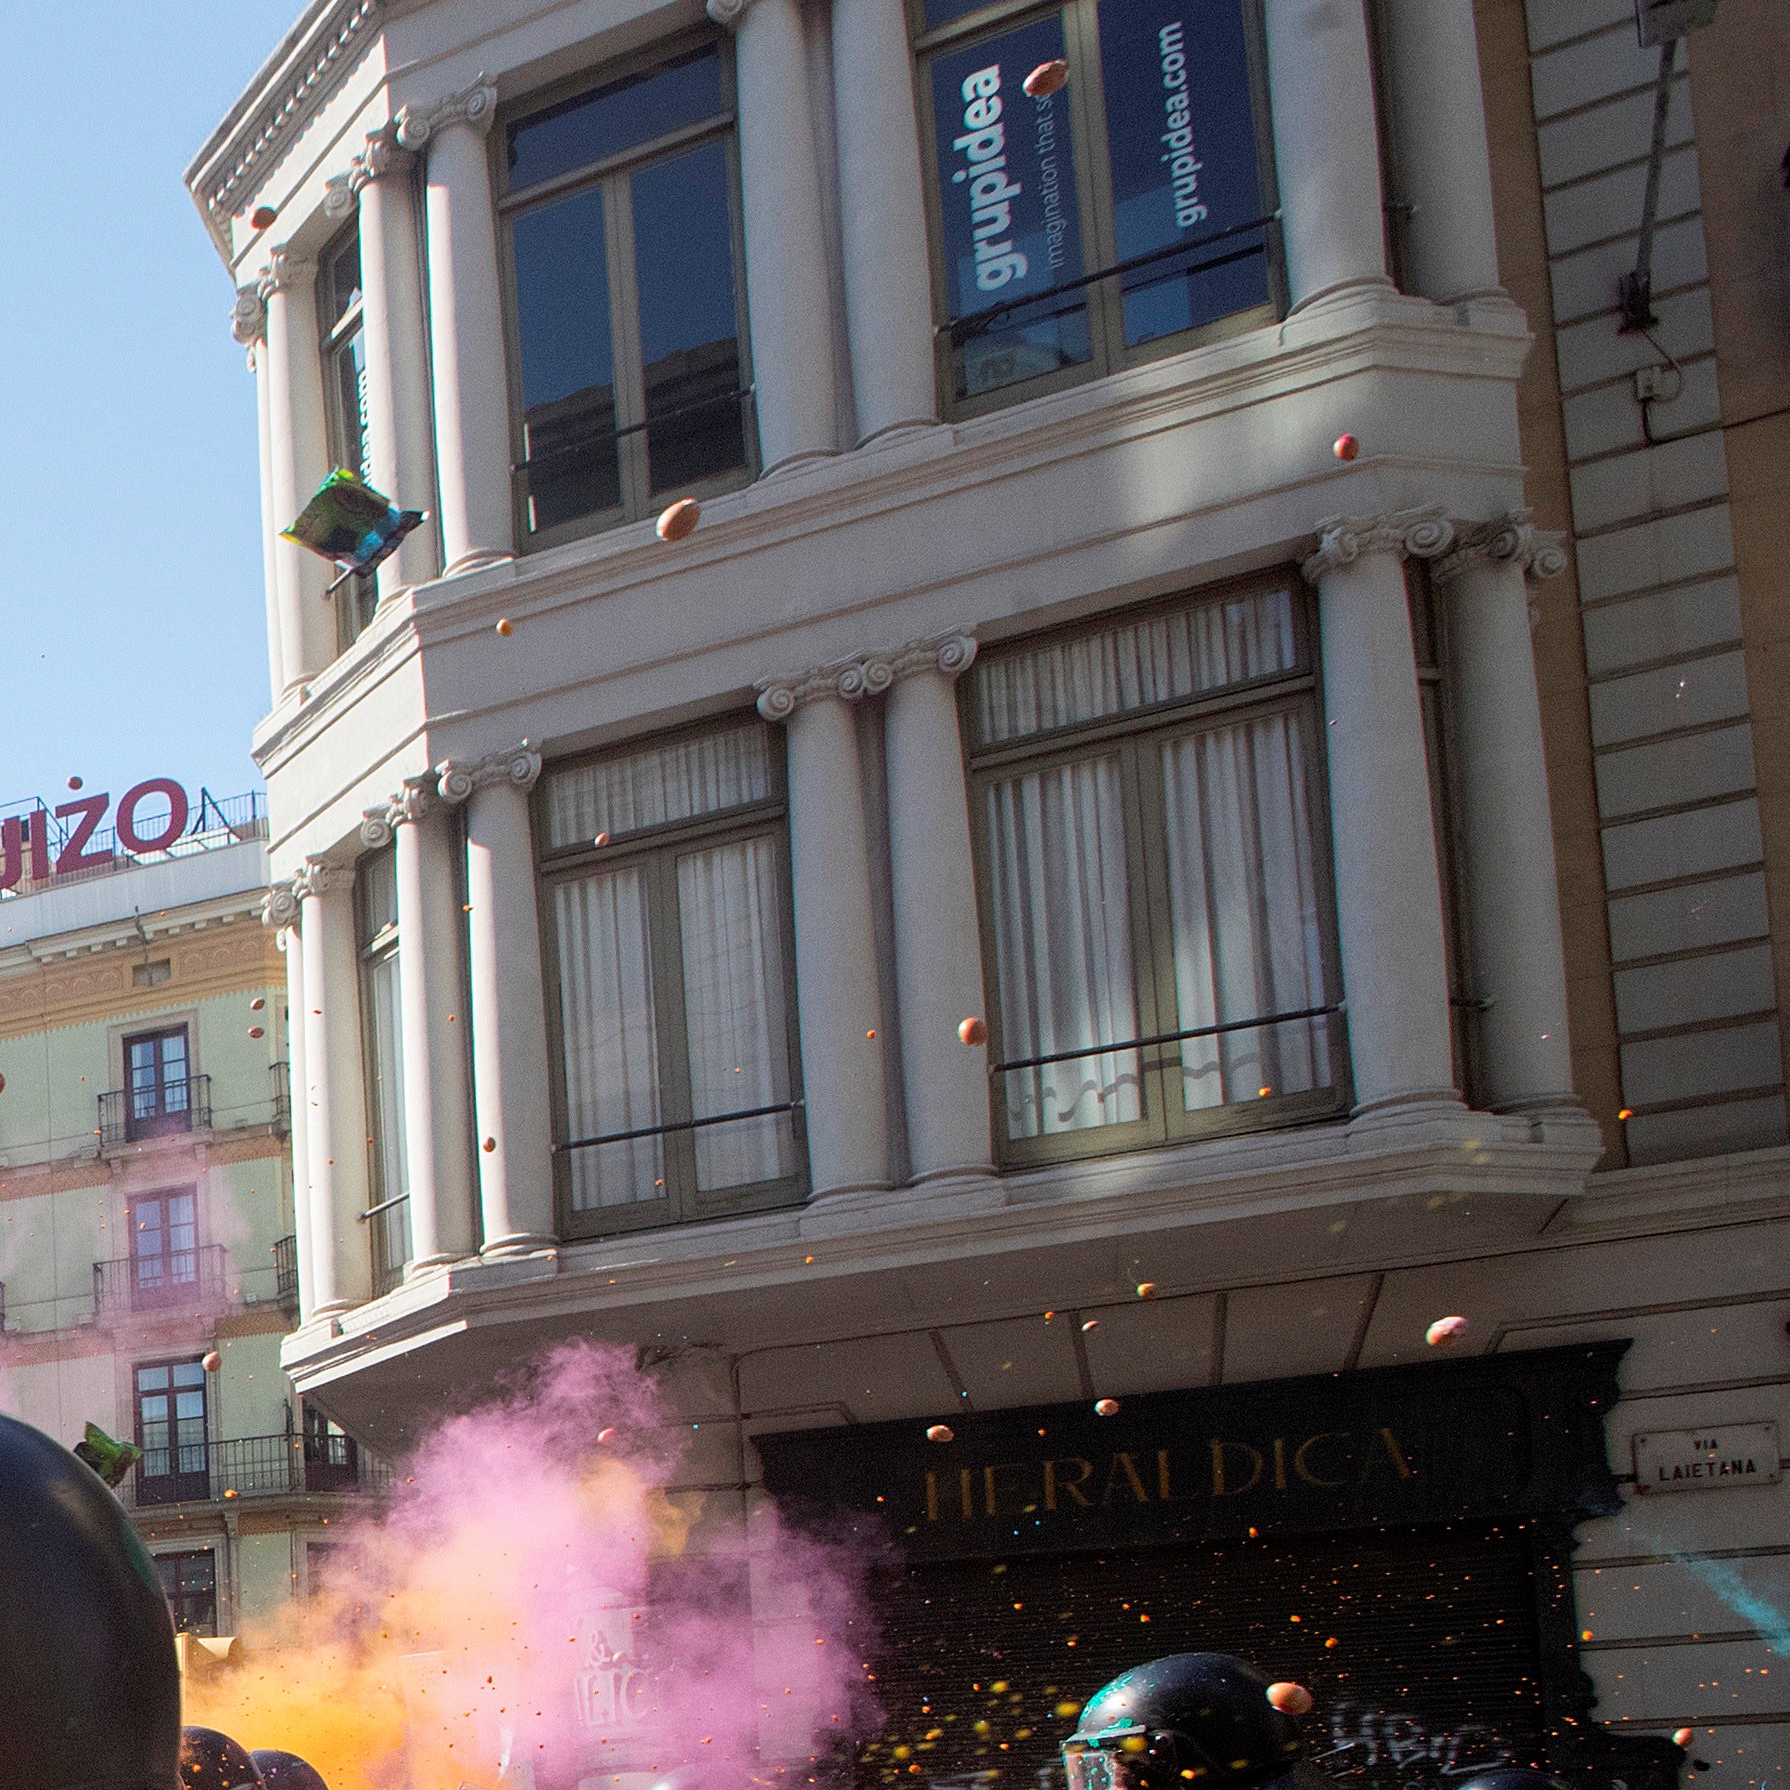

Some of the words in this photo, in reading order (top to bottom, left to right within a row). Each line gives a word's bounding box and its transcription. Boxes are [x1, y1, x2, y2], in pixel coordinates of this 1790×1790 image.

[1033, 111, 1057, 156] that
[1157, 20, 1208, 228] grupidea.com
[951, 63, 1028, 292] grupidea
[1038, 155, 1068, 270] imagination
[925, 1427, 1416, 1521] HERALDICA
[1659, 1459, 1757, 1482] LAIETANA
[1693, 1439, 1718, 1451] VIA
